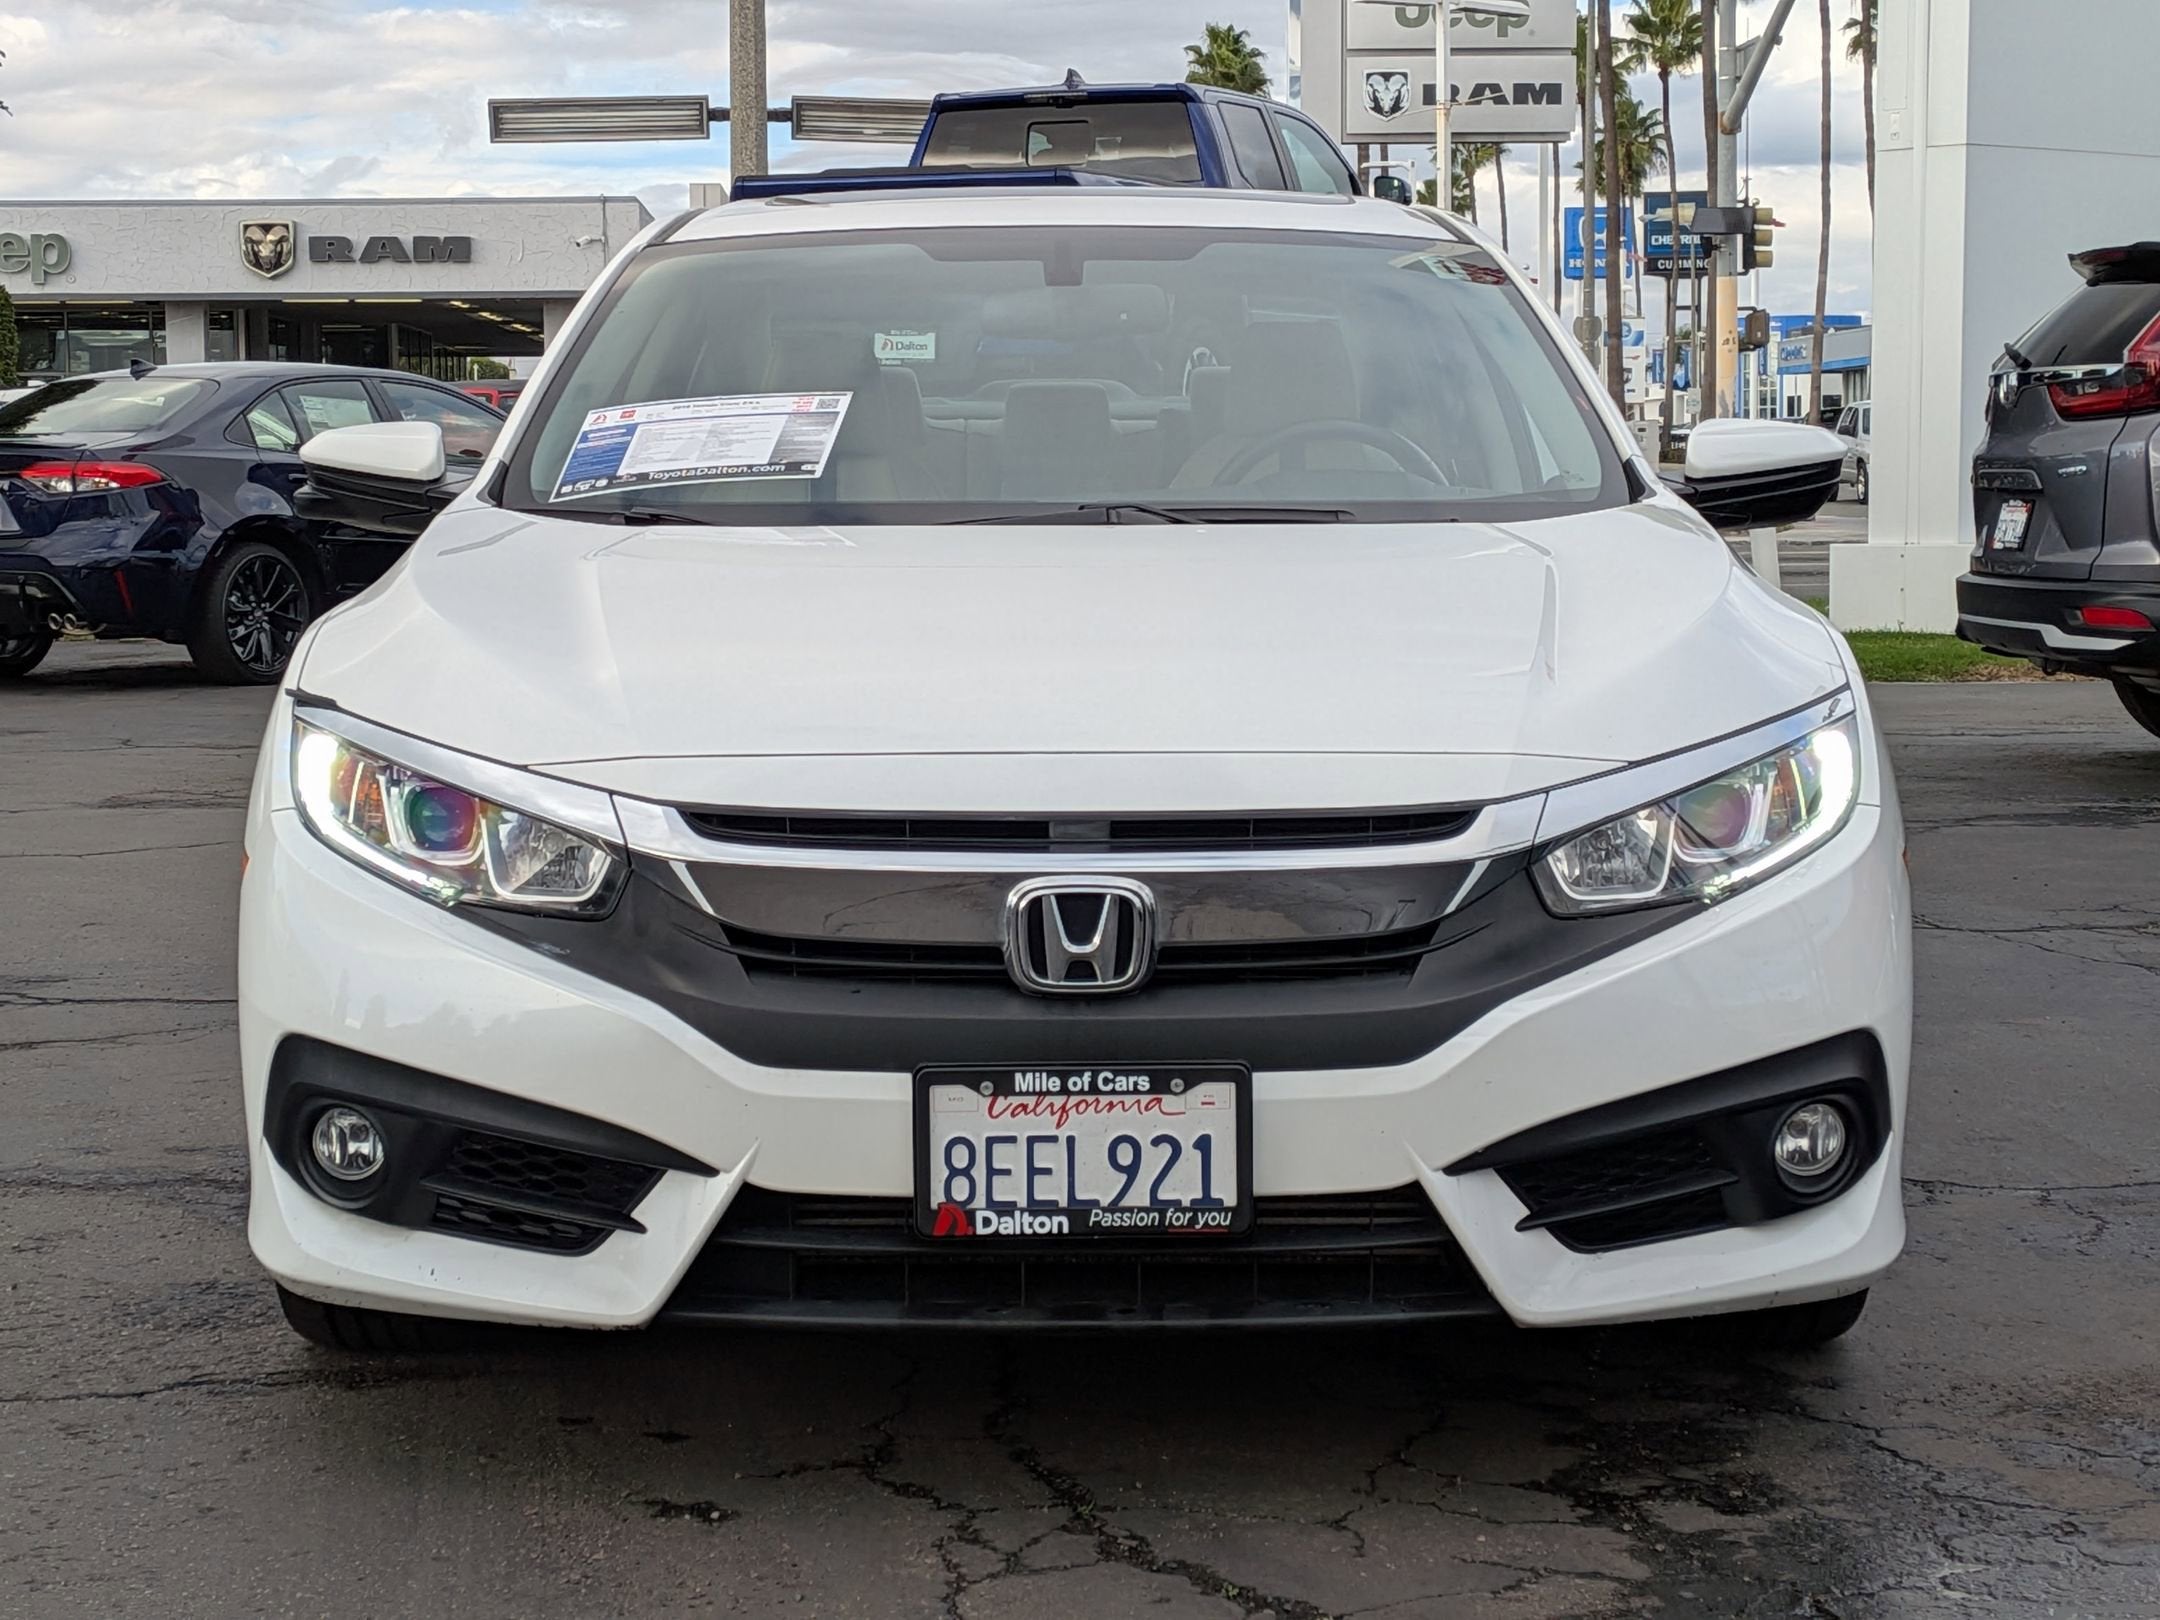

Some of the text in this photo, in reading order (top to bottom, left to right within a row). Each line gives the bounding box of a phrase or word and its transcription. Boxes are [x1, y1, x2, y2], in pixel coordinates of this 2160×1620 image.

[1422, 83, 1563, 106] RAM
[308, 236, 472, 263] RAM
[895, 341, 928, 351] Dalton
[648, 463, 786, 481] ToyotaDalton.com
[1014, 1071, 1150, 1093] Mile of Cars
[988, 1093, 1186, 1131] California
[943, 1133, 1225, 1209] 8EEL921
[975, 1208, 1232, 1235] Dalton Passion for you
